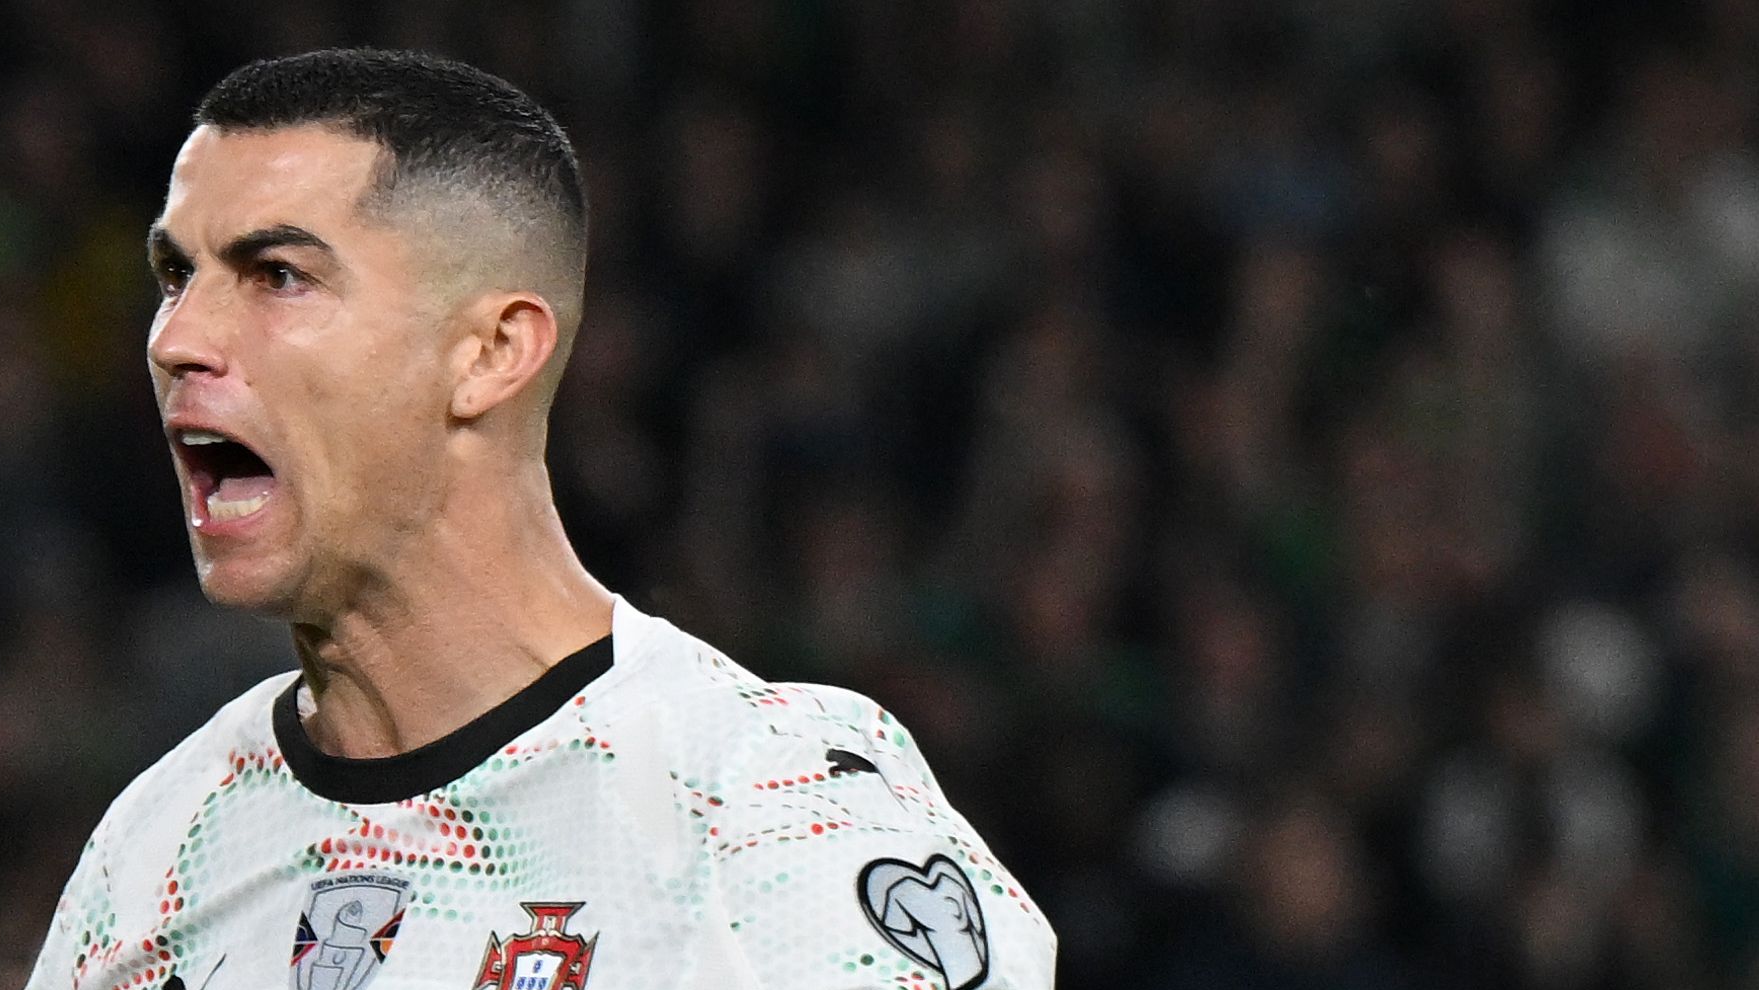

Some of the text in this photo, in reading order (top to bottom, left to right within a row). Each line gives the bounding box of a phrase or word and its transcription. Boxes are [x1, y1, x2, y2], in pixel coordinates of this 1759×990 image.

[311, 875, 410, 891] UEFA NATIONS LEAGUE
